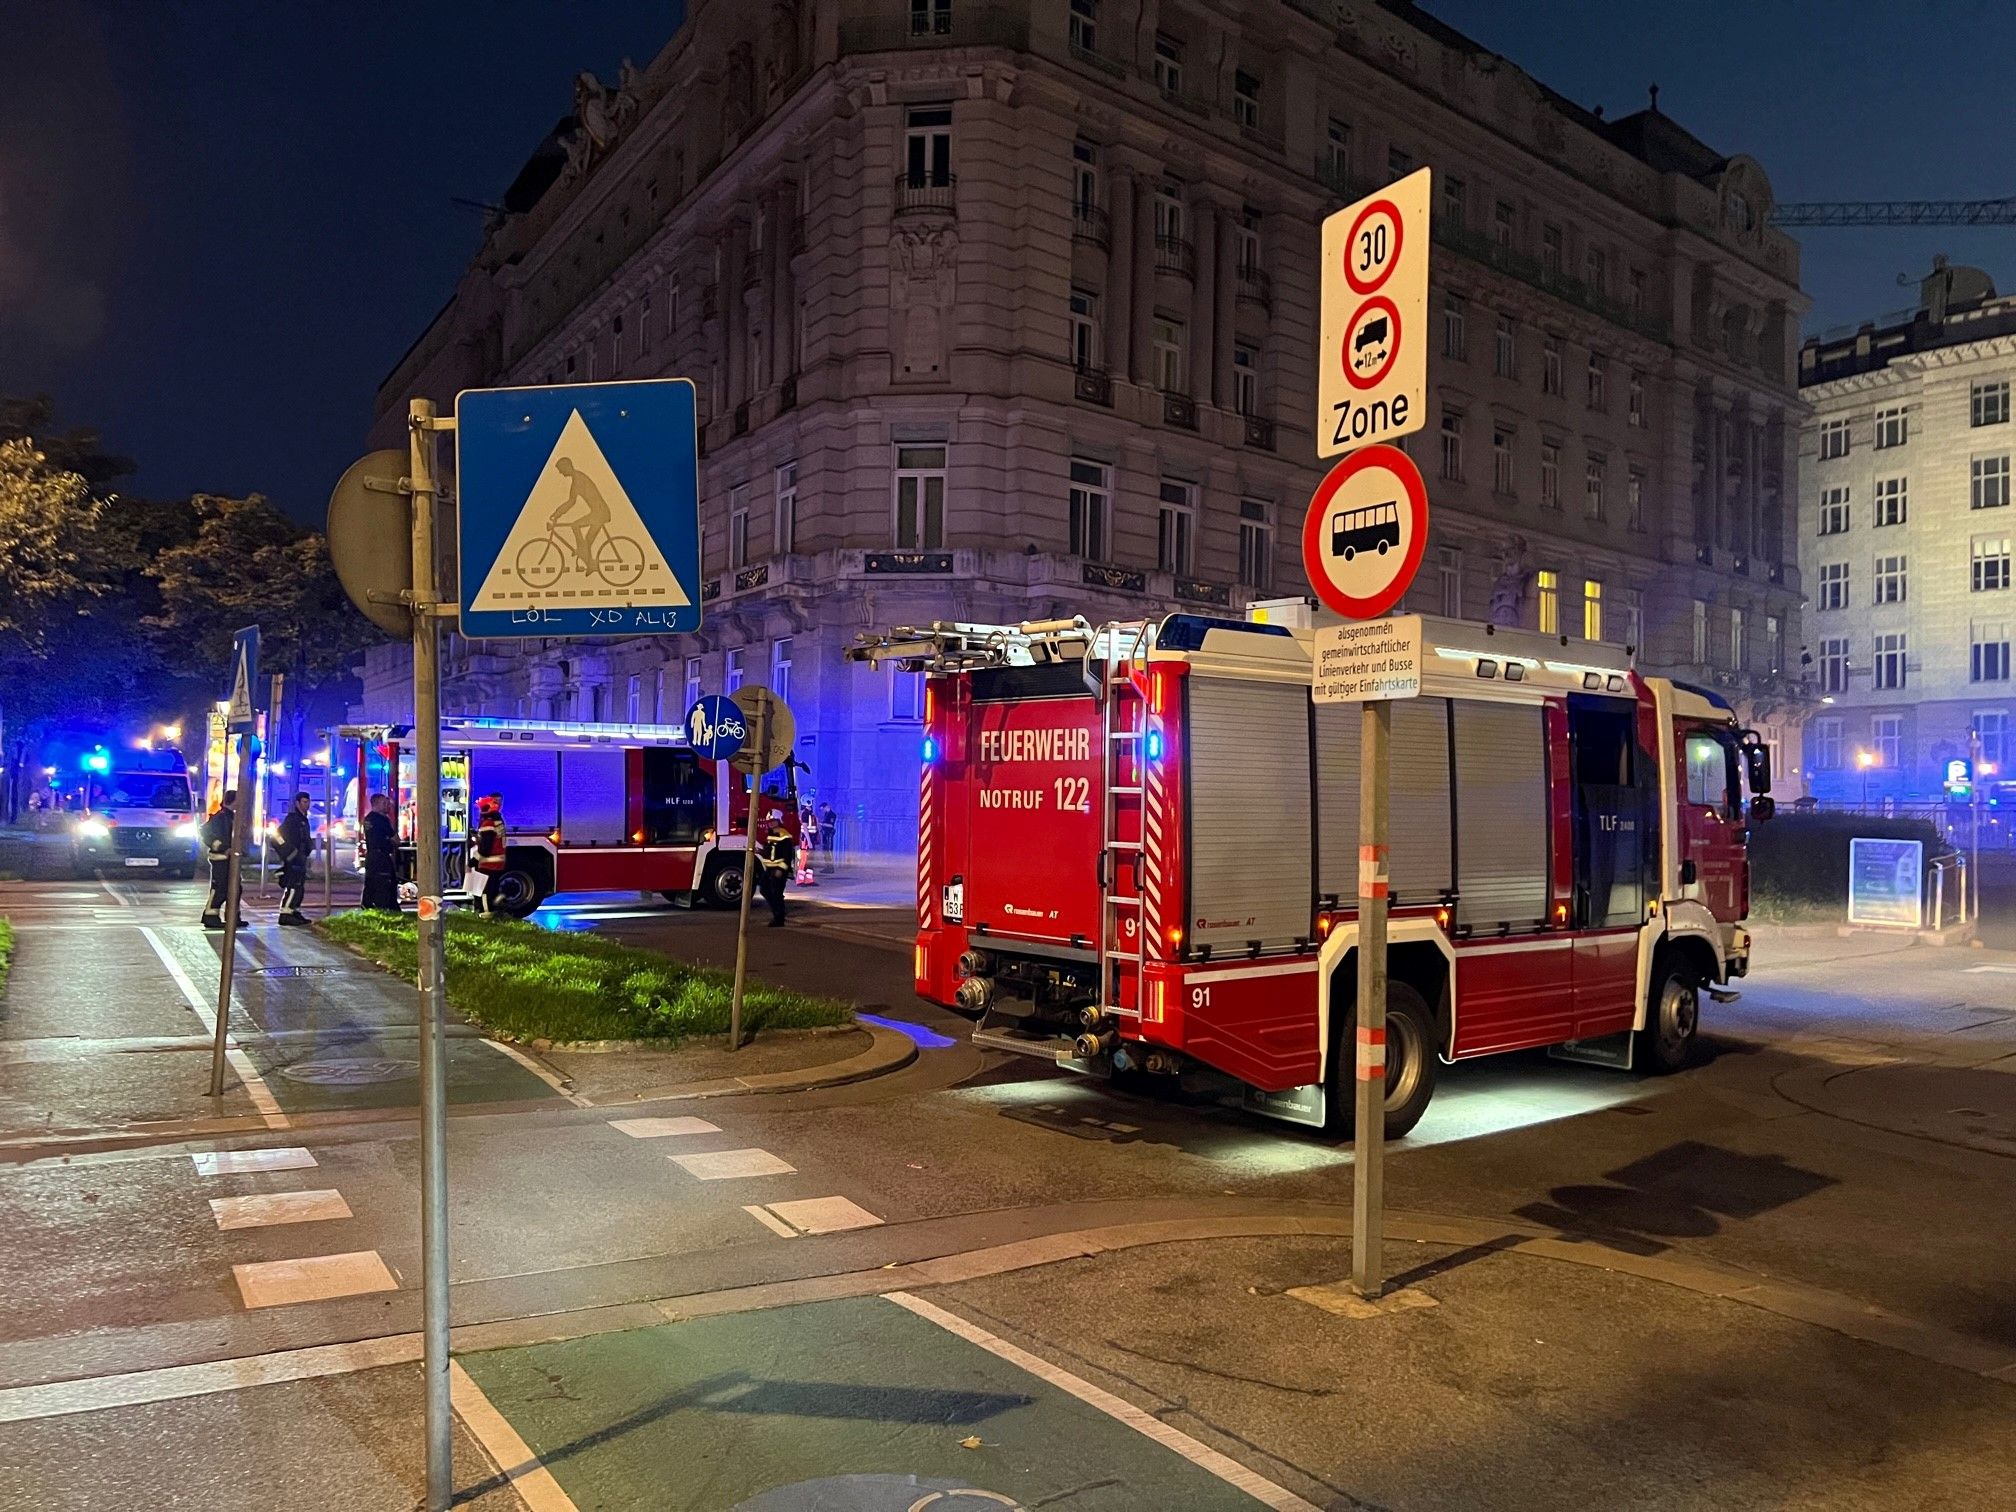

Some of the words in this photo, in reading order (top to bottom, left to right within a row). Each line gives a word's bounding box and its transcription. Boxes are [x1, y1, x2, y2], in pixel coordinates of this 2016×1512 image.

[1360, 224, 1386, 271] 30
[1333, 393, 1408, 445] Zone
[512, 608, 562, 623] LOL
[590, 610, 623, 627] XD
[1338, 622, 1393, 641] ausgenommen
[1322, 639, 1410, 662] gemeinwirtschaftlicher
[1319, 662, 1369, 678] Linienverkehr
[1371, 660, 1387, 673] und
[1389, 659, 1413, 671] Busse
[1314, 682, 1326, 695] mit
[1328, 680, 1358, 697] gültiger
[1360, 677, 1418, 692] Einfahrtskarte
[981, 728, 1089, 762] FEUERWEHR
[980, 789, 1043, 809] NOTRUF
[1054, 777, 1090, 811] 122
[1600, 815, 1617, 831] TLF
[1049, 910, 1059, 919] AT
[1192, 987, 1210, 1008] 91
